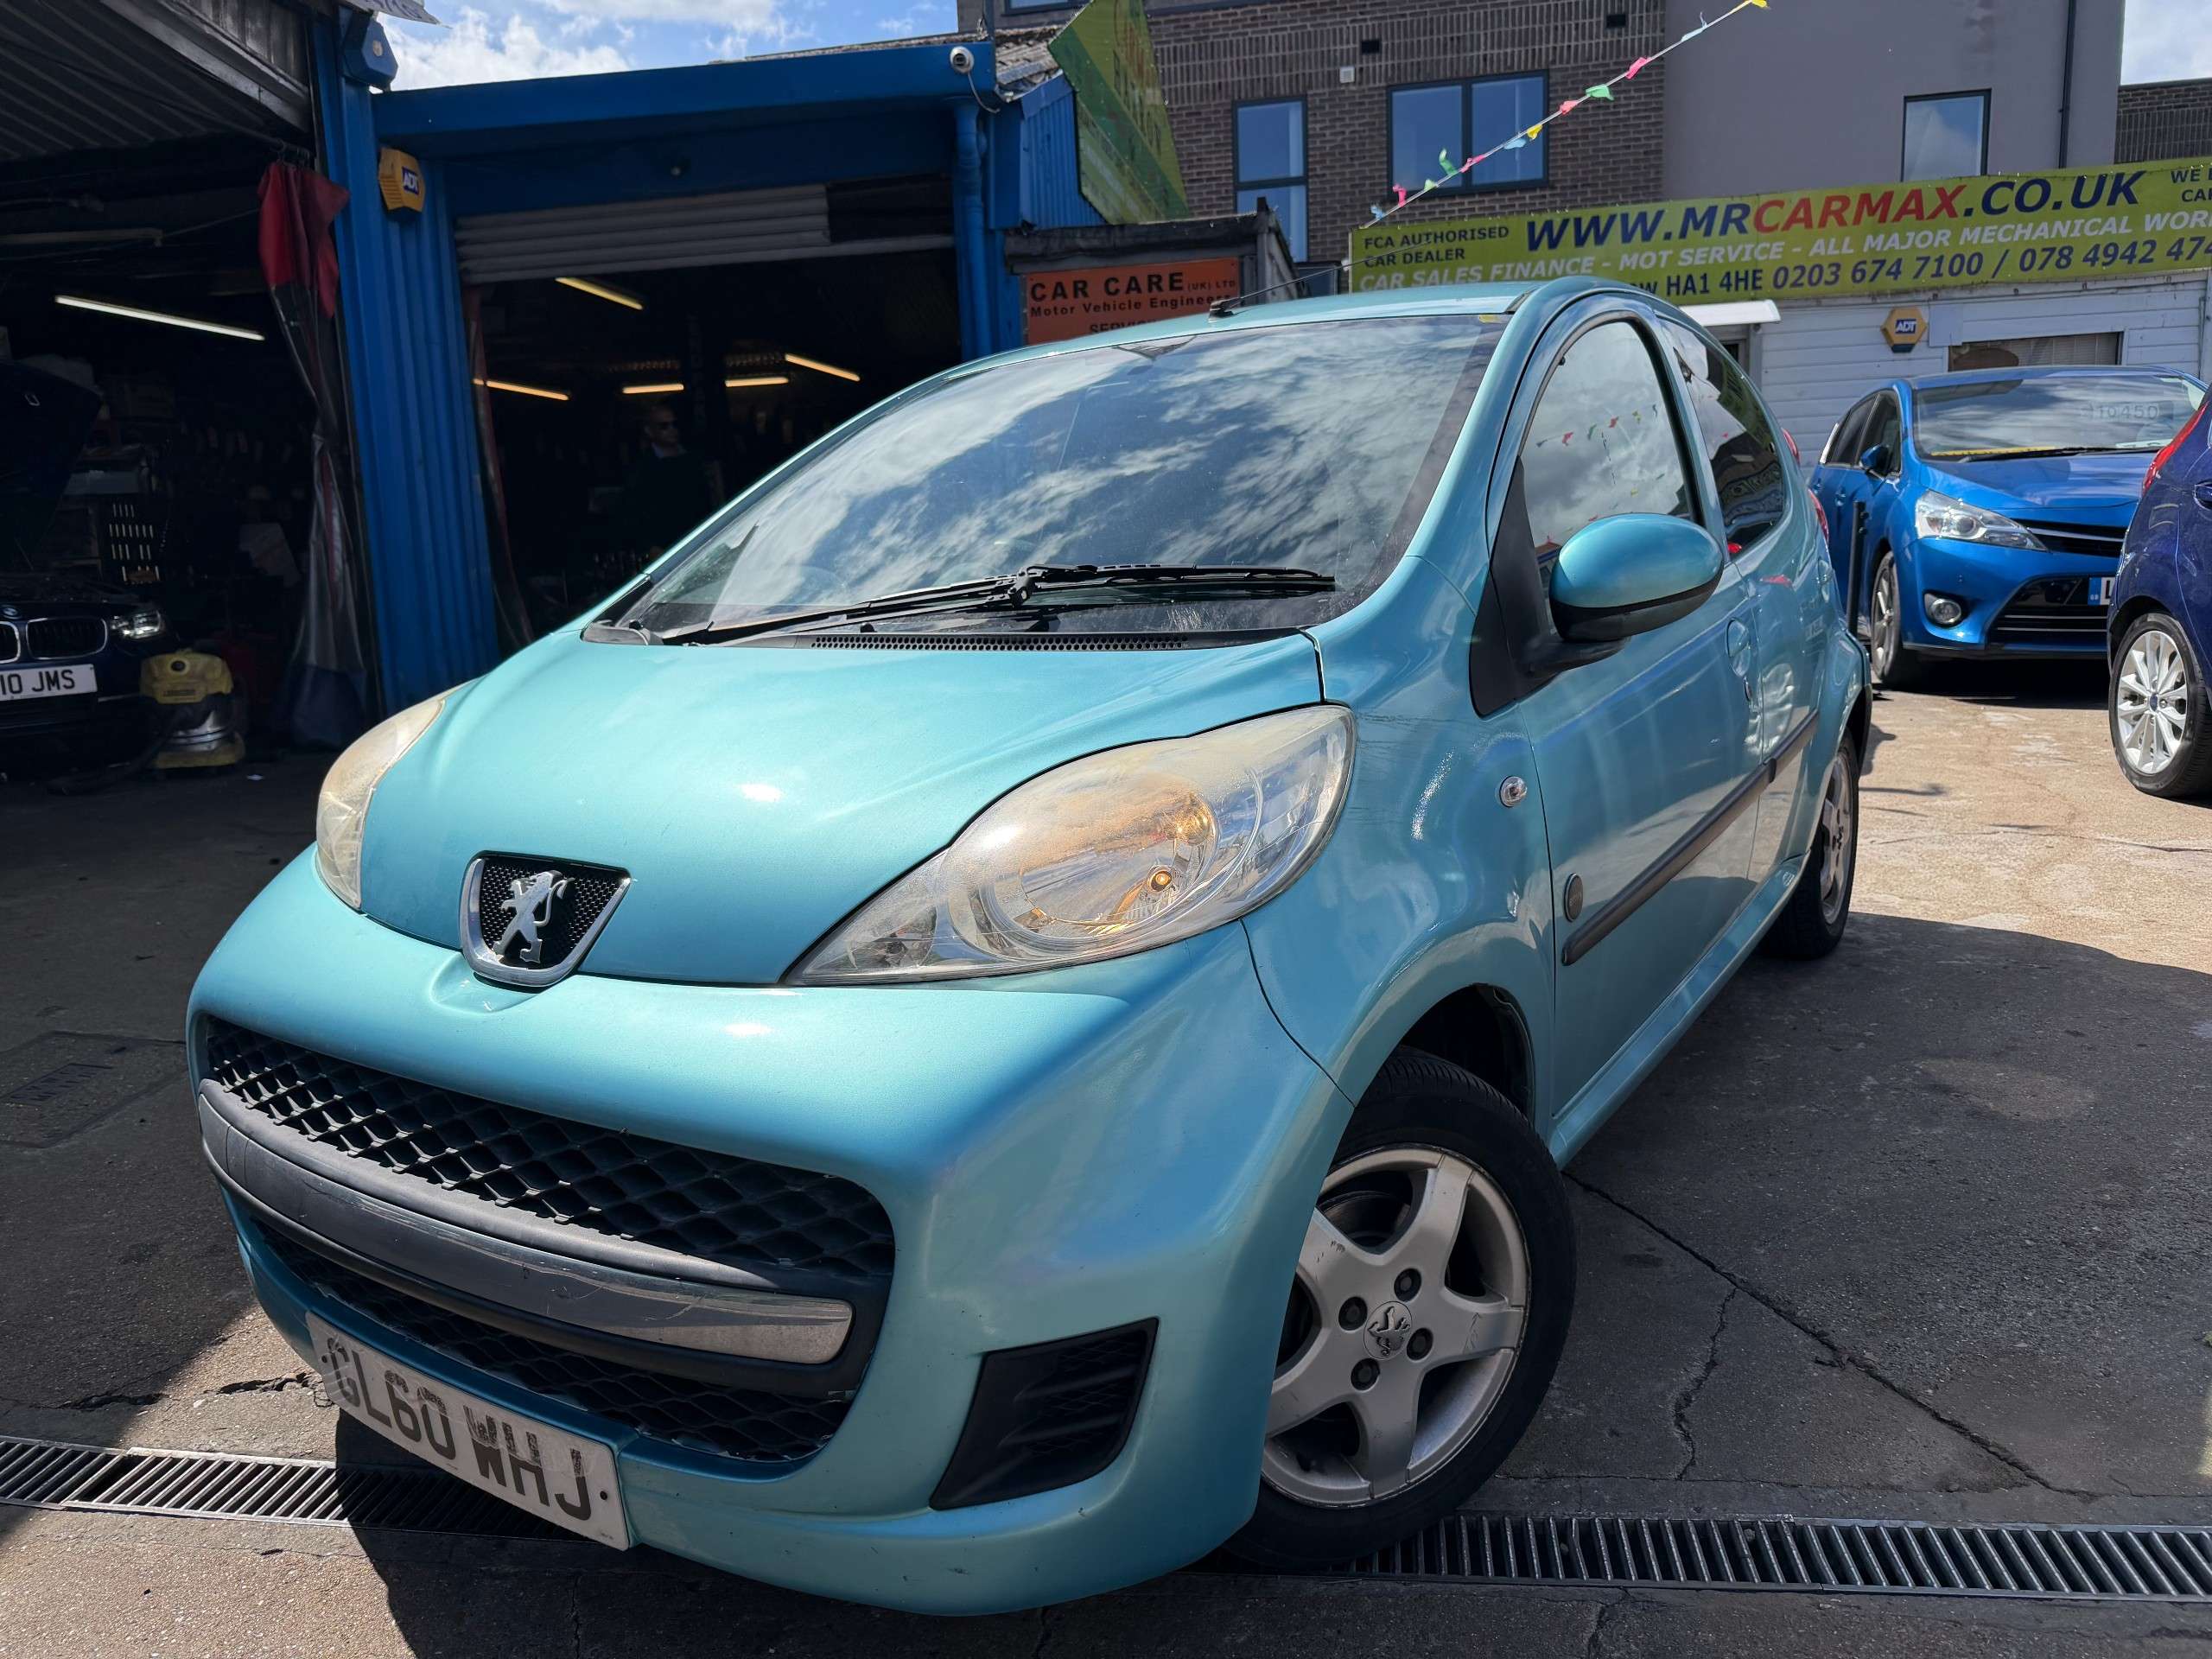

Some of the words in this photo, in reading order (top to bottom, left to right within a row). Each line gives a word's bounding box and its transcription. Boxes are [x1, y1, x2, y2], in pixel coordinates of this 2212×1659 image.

[404, 171, 418, 194] ADT
[2171, 168, 2201, 184] WE
[2182, 188, 2212, 203] CA
[1526, 170, 2148, 252] WWW.MRCARMAX.CO.UK
[1364, 237, 1395, 251] FCA
[1400, 226, 1510, 247] AUTHORISED
[1359, 273, 1404, 292] CAR
[1408, 266, 1485, 288] SALES
[1490, 257, 1595, 282] FINANCE
[1619, 249, 1669, 271] MOT
[1676, 240, 1784, 267] SERVICE
[1808, 238, 1855, 257] ALL
[1863, 229, 1951, 253] MAJOR
[1959, 215, 2132, 246] MECHANICAL
[2144, 210, 2212, 232] WOR
[1364, 251, 1397, 268] CAR
[1402, 248, 1465, 265] DEALER
[1666, 272, 1710, 296] HA1
[1720, 267, 1764, 291] 4HE
[1772, 263, 1840, 289] 0203
[1850, 258, 1902, 283] 674
[1914, 251, 1984, 279] 7100
[1992, 249, 2011, 279] /
[2018, 245, 2073, 272] 078
[2082, 238, 2156, 267] 4942
[1030, 279, 1090, 302] CAR
[1104, 271, 1185, 296] CARE
[1030, 305, 1075, 318] Motor
[1083, 298, 1142, 314] Vehicle
[1895, 320, 1917, 333] ADT
[31, 669, 76, 691] JMS
[462, 1404, 592, 1522] WHJ
